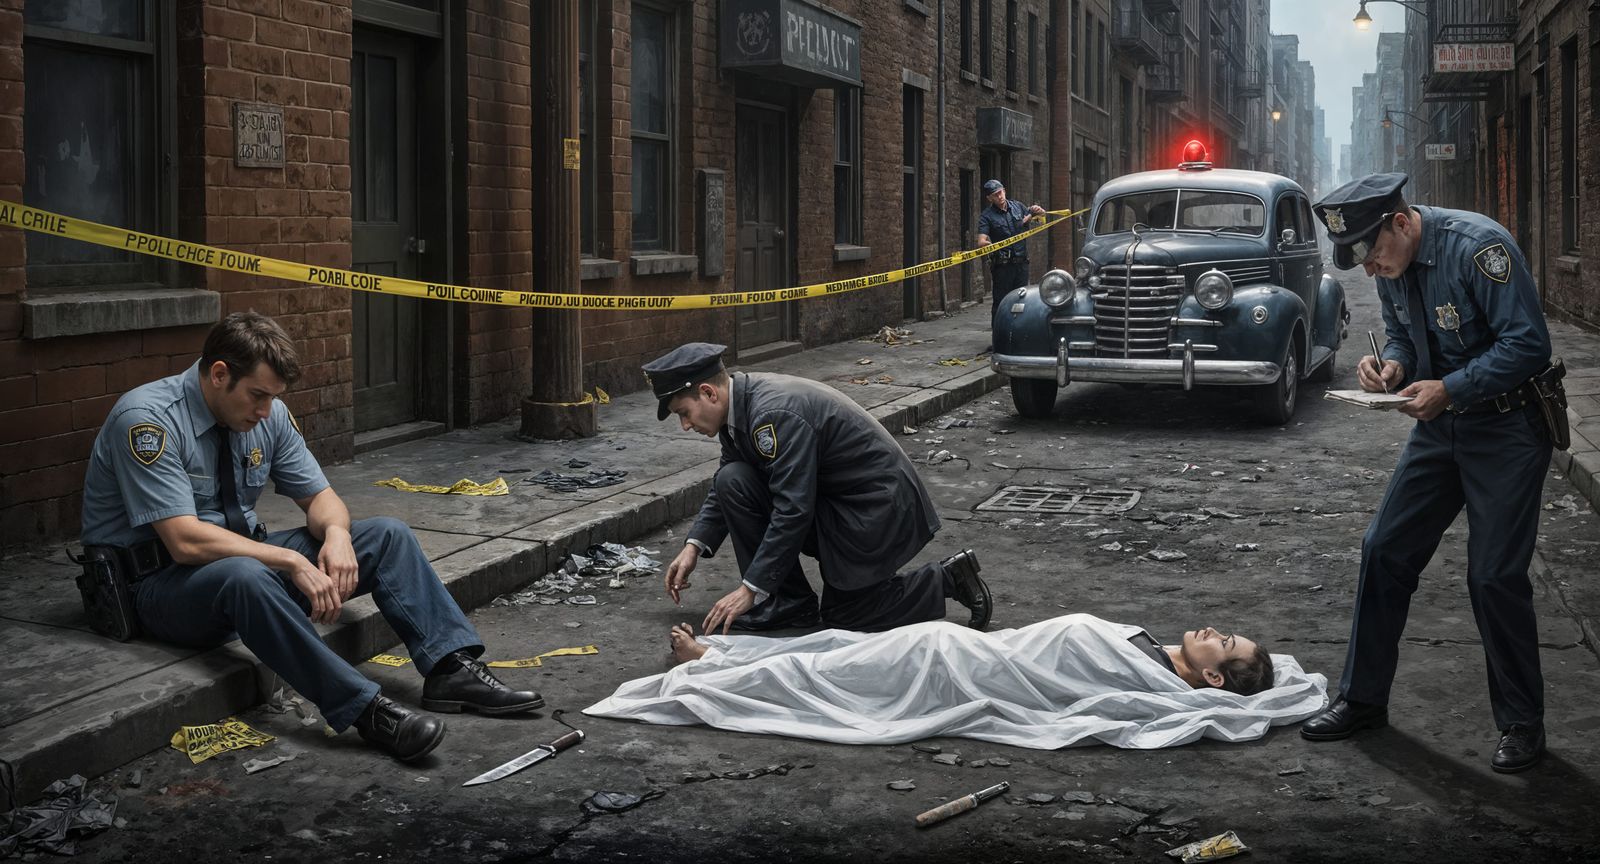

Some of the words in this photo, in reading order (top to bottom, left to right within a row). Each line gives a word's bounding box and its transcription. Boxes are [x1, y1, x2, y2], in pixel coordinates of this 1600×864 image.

[125, 232, 173, 256] PPOLL
[176, 244, 215, 264] CHCE
[308, 267, 349, 287] POABL
